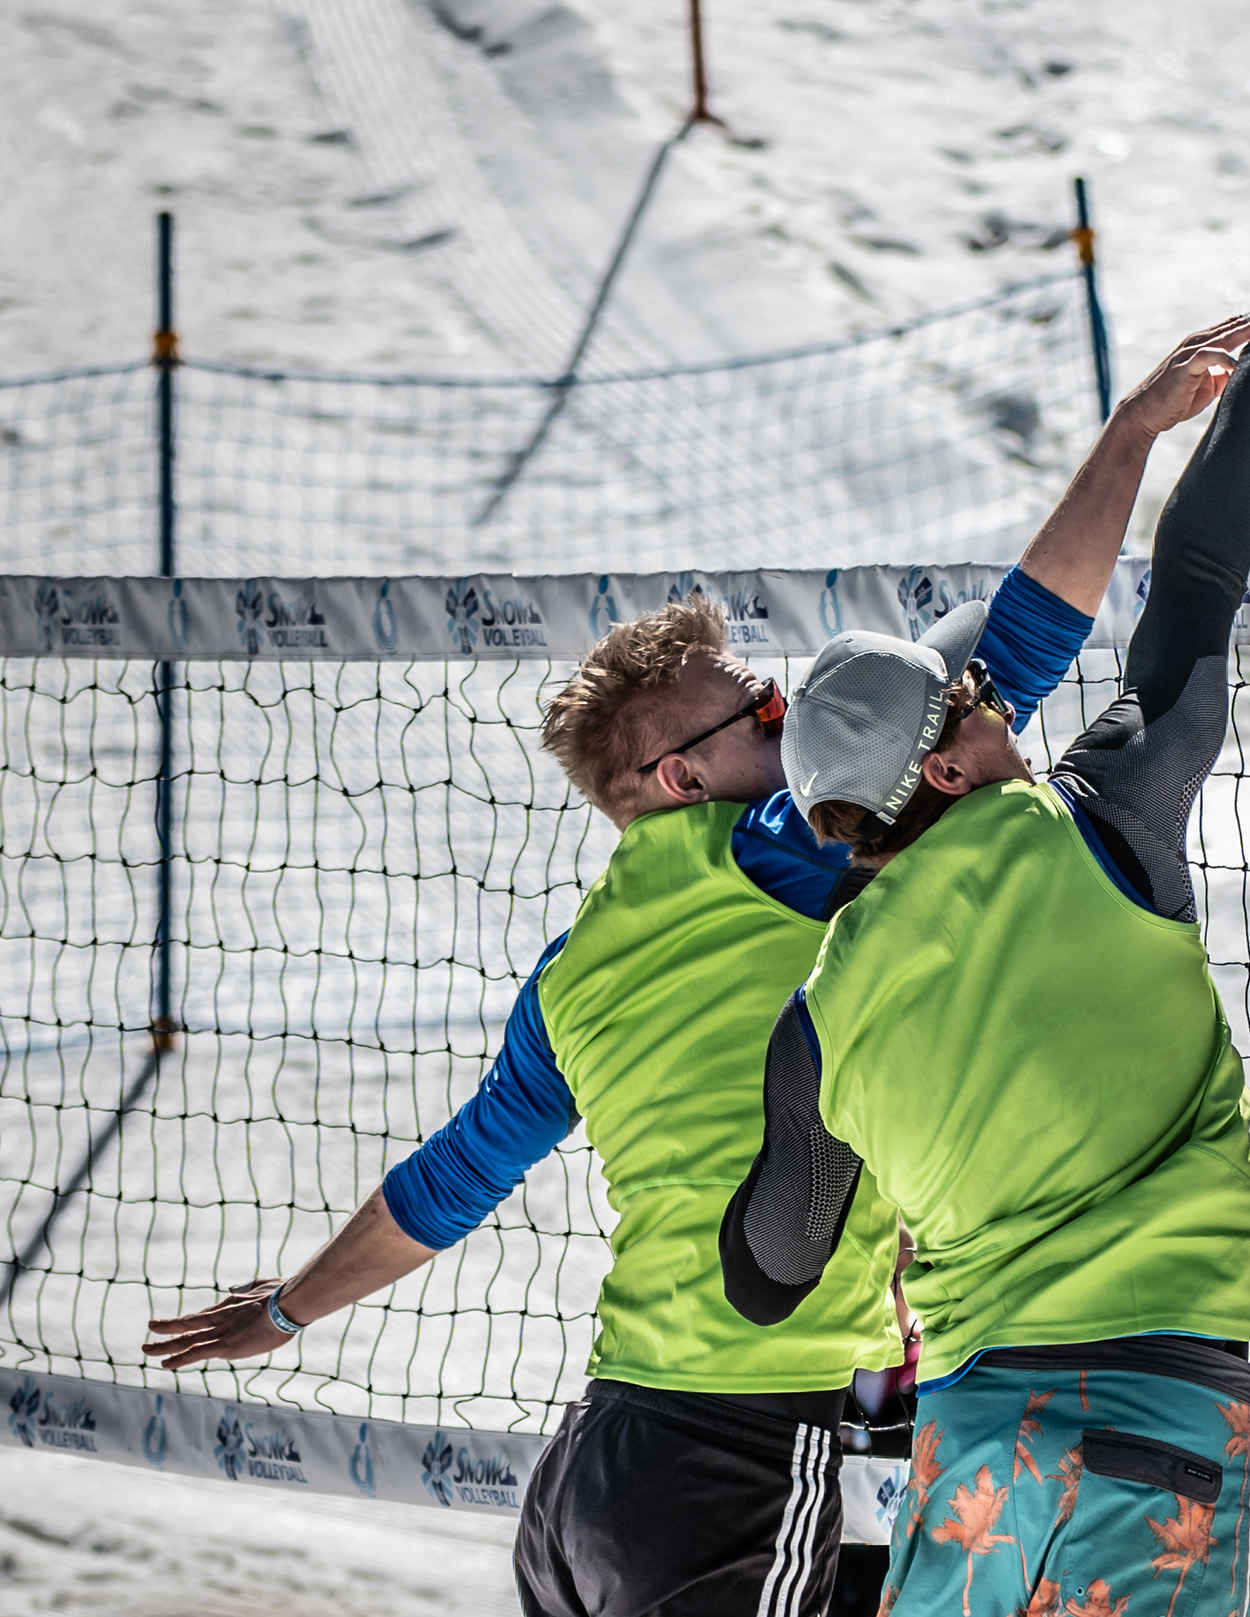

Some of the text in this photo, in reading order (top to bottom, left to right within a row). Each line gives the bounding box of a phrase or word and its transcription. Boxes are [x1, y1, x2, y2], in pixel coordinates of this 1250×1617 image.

[266, 590, 309, 628] SN
[729, 625, 769, 643] EBALL
[885, 690, 944, 811] NIKE TRAIL
[454, 1447, 502, 1486] SNOW
[456, 1486, 520, 1508] VOLLEYBALL
